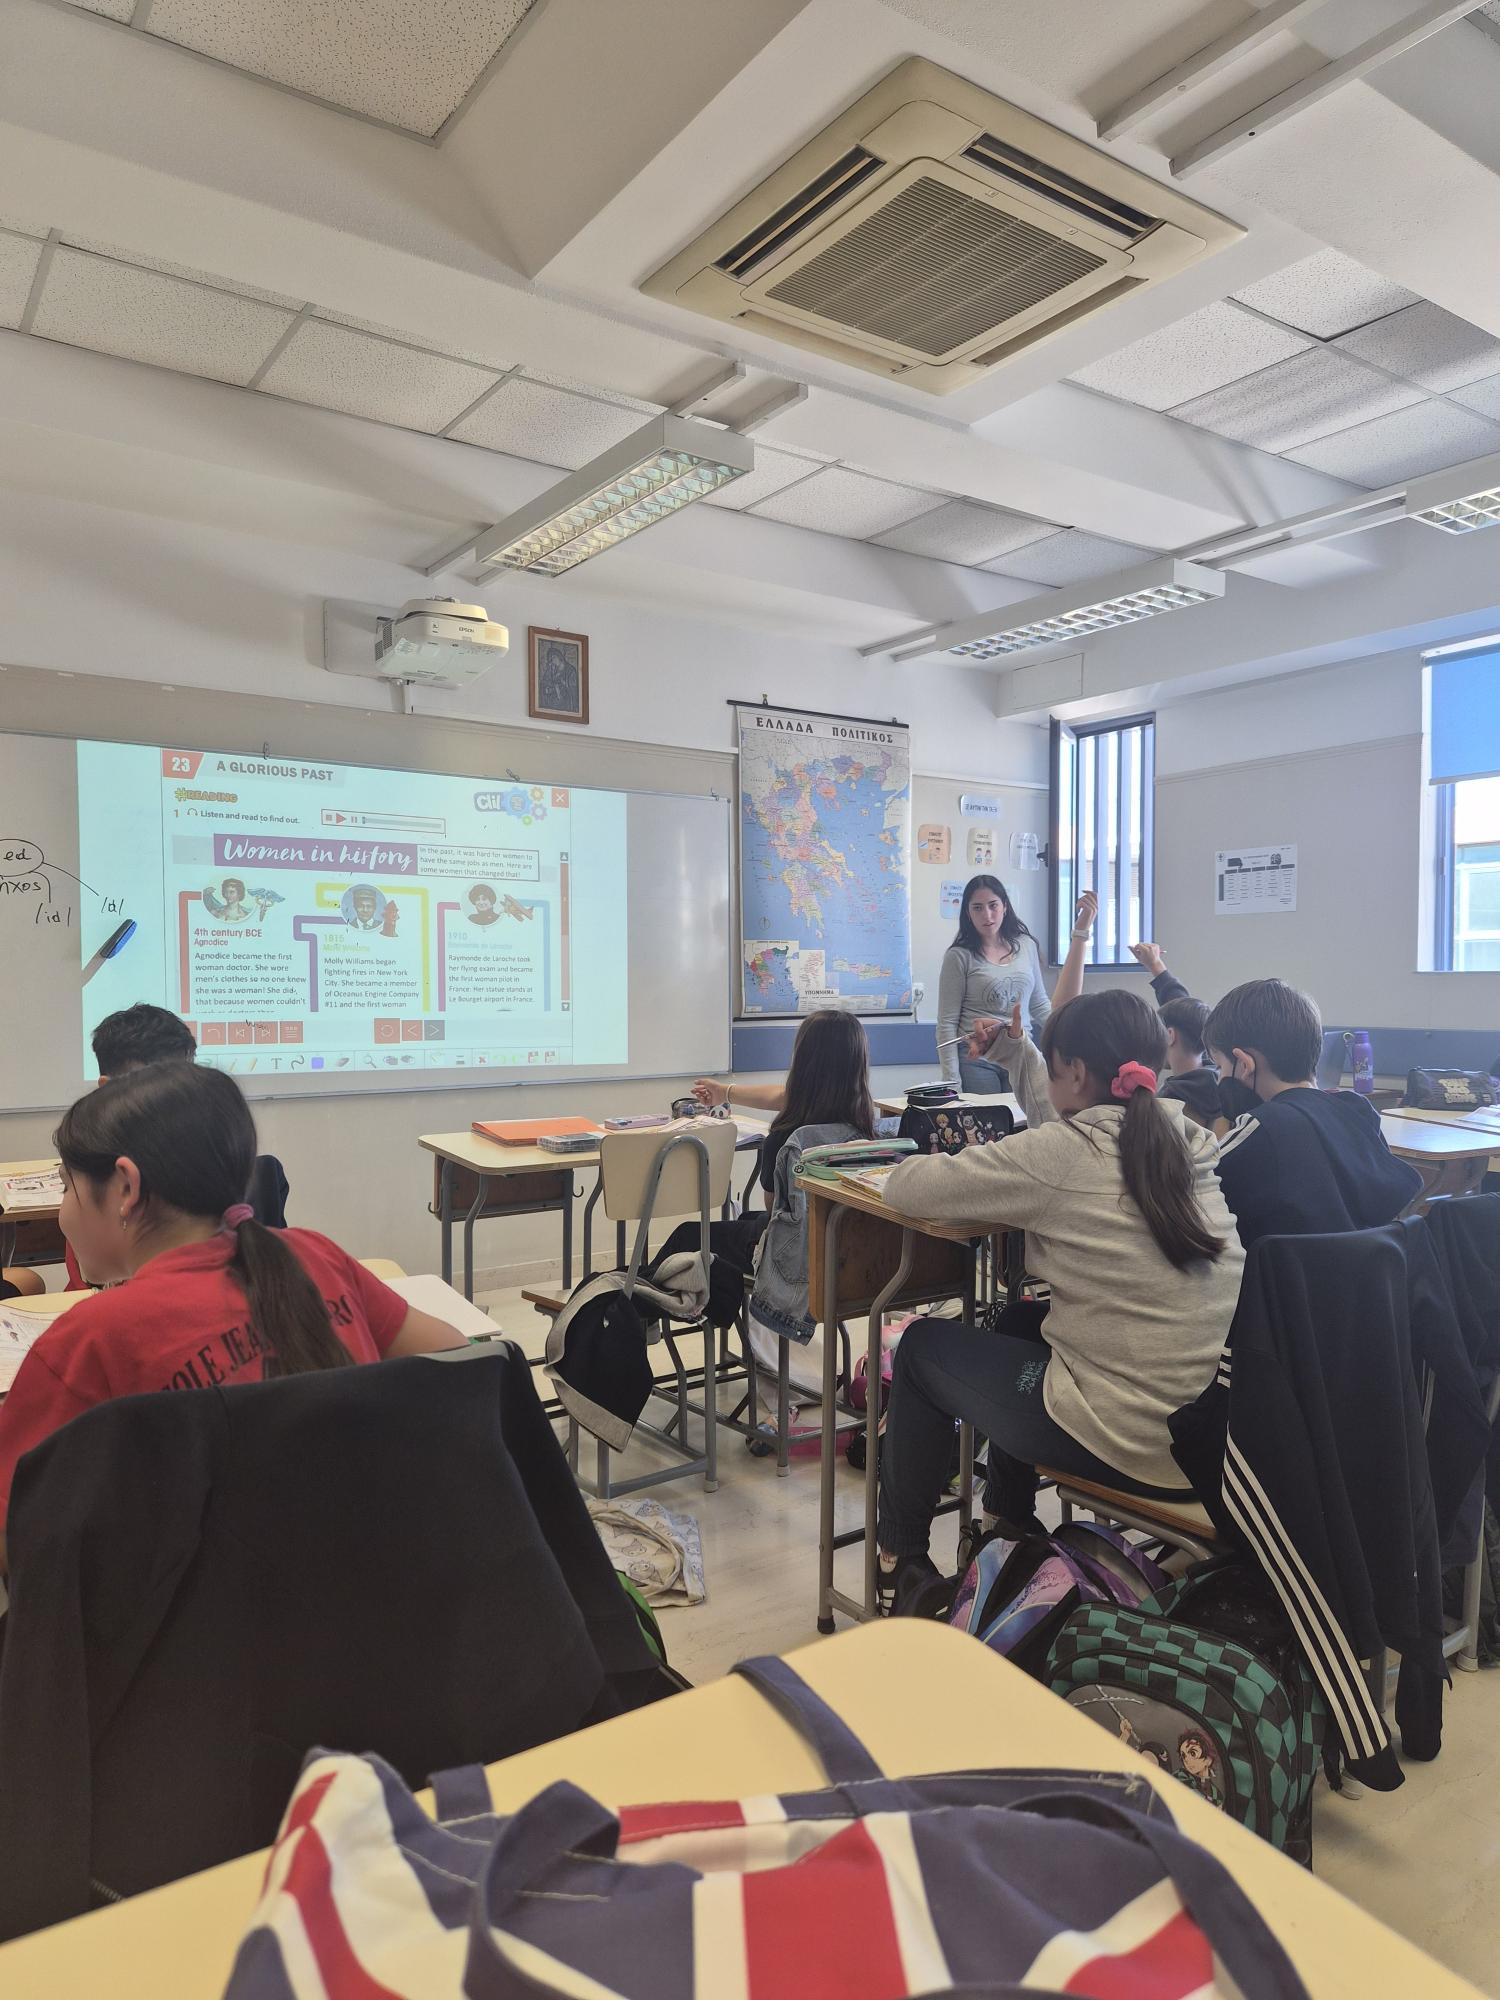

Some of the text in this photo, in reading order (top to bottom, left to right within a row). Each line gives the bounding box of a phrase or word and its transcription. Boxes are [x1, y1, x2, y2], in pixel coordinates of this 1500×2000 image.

[756, 717, 893, 744] ΕΛΛΑΔΑ ΠΟΛΙΤΙΚΟΣ
[171, 756, 190, 772] 23
[216, 760, 334, 781] A GLORIOUS PAST
[174, 809, 180, 818] 1
[200, 810, 224, 819] Listen
[225, 811, 240, 820] and
[242, 812, 258, 821] read
[260, 813, 268, 822] to
[269, 814, 284, 823] find
[223, 838, 414, 872] Women in history
[420, 846, 426, 854] In
[427, 847, 439, 855] the
[456, 848, 462, 856] it
[476, 850, 491, 858] hard
[492, 850, 501, 859] for
[502, 852, 525, 860] women
[420, 856, 435, 864] have
[437, 857, 448, 866] the
[466, 859, 480, 868] jobs
[506, 861, 522, 870] Here
[420, 866, 438, 874] some
[464, 868, 477, 876] that
[478, 868, 504, 878] changed
[194, 928, 262, 939] 4th century BCE
[194, 938, 228, 947] Agnodice
[194, 952, 292, 962] Agnodice became the first
[324, 957, 396, 967] Molly Williams began
[449, 954, 531, 963] Raymonde de Laroche took
[195, 964, 224, 972] woman
[226, 963, 253, 972] doctor.
[255, 964, 269, 972] She
[324, 968, 408, 977] fighting fires in New York
[460, 965, 478, 974] flying
[195, 975, 219, 983] men's
[221, 976, 248, 984] clothes
[287, 976, 306, 984] knew
[324, 979, 339, 988] City.
[341, 979, 354, 987] She
[356, 979, 382, 987] became
[390, 980, 417, 988] member
[498, 976, 513, 985] pilot
[195, 986, 210, 994] she
[267, 986, 281, 994] She
[324, 990, 420, 1000] of Oceanus Engine Company
[195, 997, 306, 1006] that because women couldn't
[458, 996, 482, 1004] Bourget
[484, 996, 504, 1005] airport
[513, 996, 535, 1004] France.
[161, 1344, 226, 1391] OLE
[220, 1320, 272, 1372] JEA
